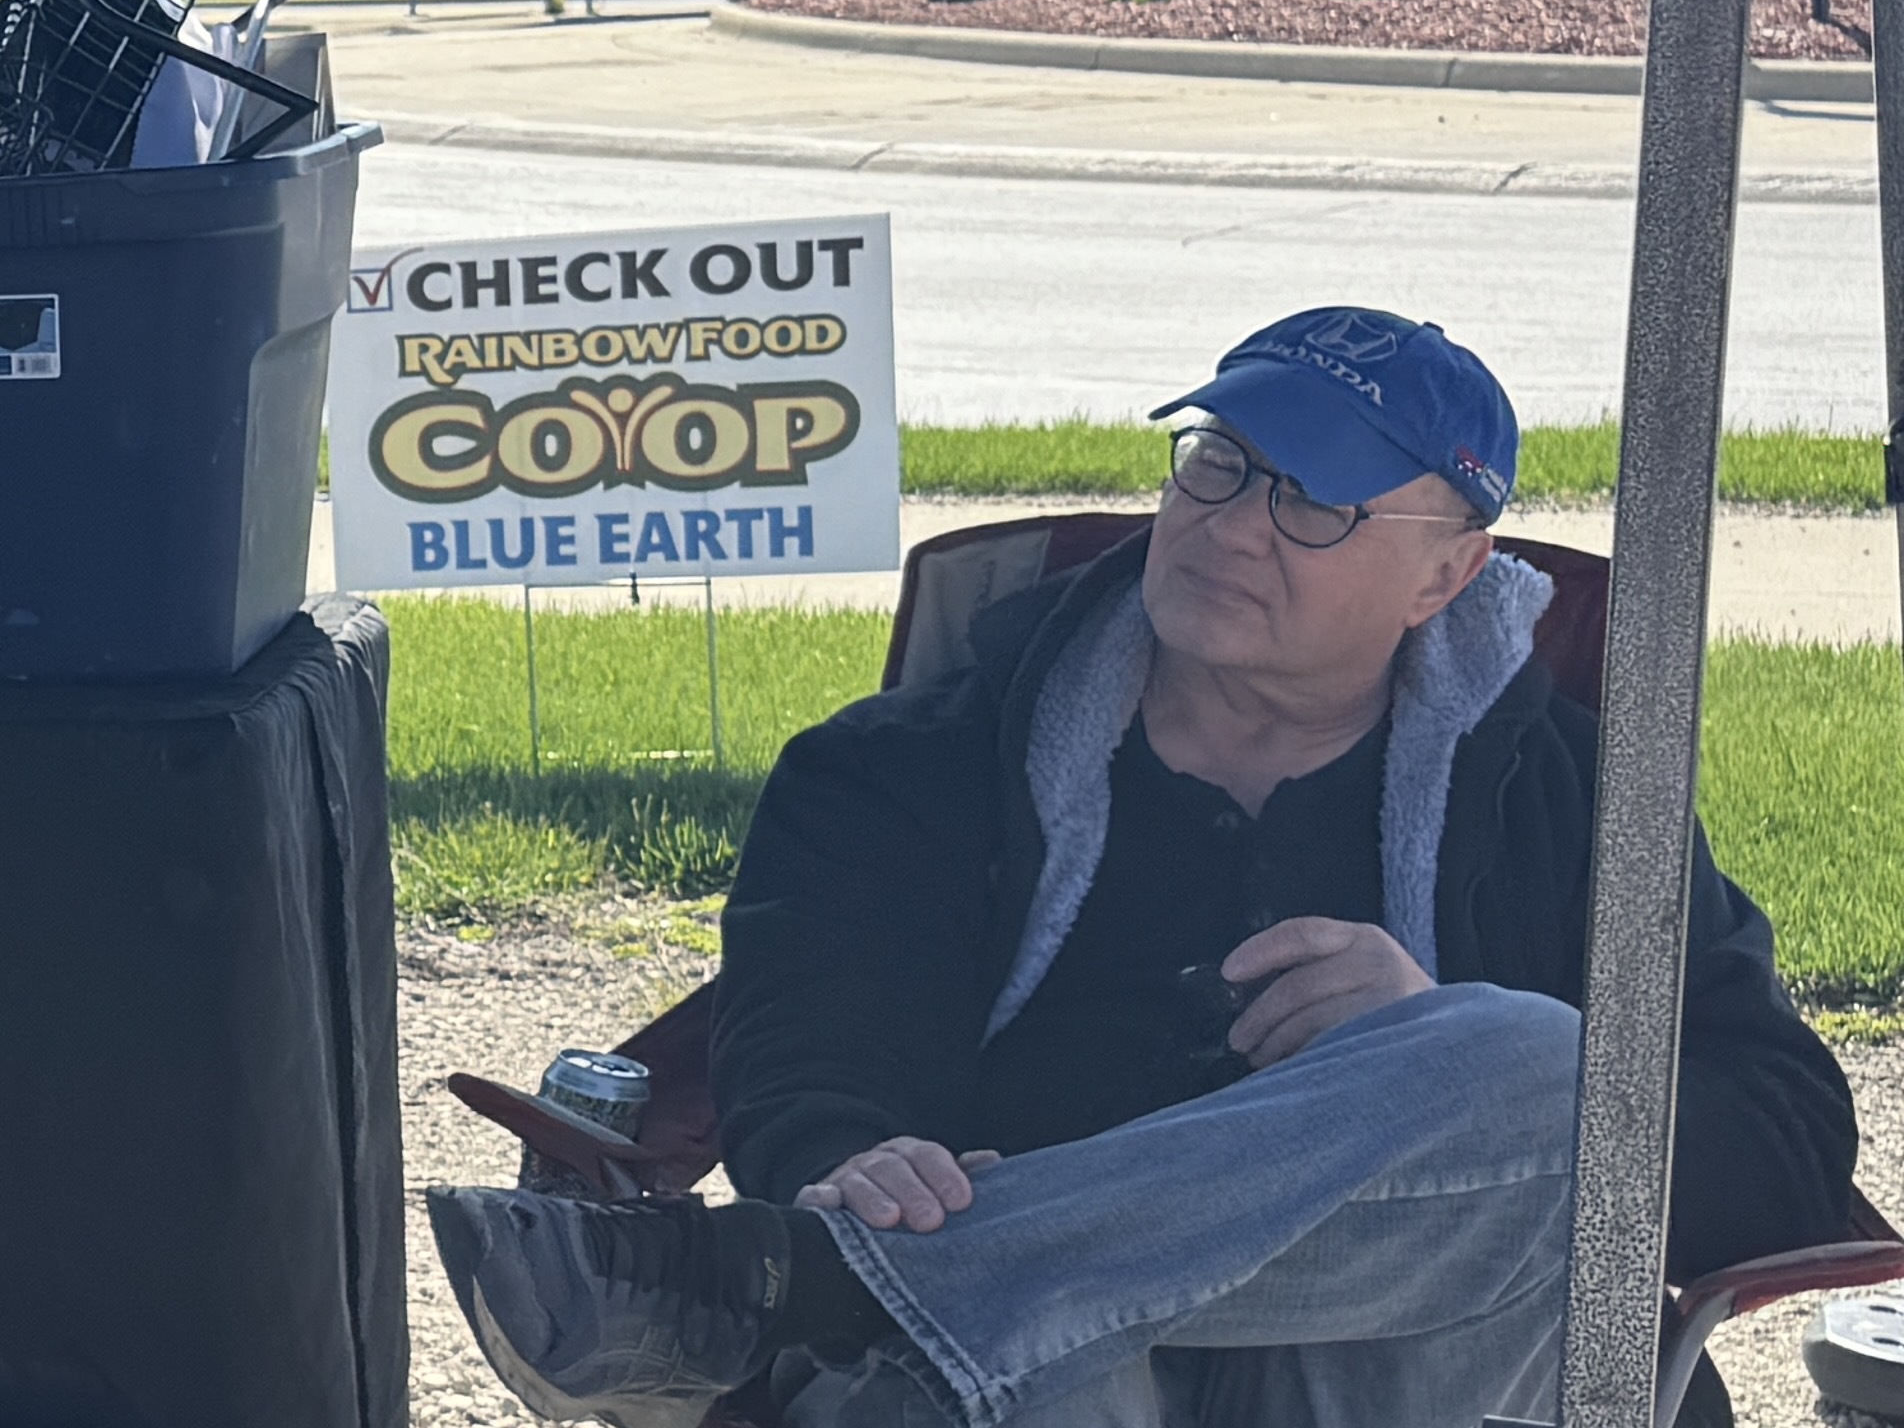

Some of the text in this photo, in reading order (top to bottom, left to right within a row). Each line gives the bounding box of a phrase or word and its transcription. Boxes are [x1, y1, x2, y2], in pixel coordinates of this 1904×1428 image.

[405, 237, 866, 314] CHECK OUT
[396, 313, 848, 389] RAINBOW FOOD
[407, 504, 816, 572] BLUE EARTH
